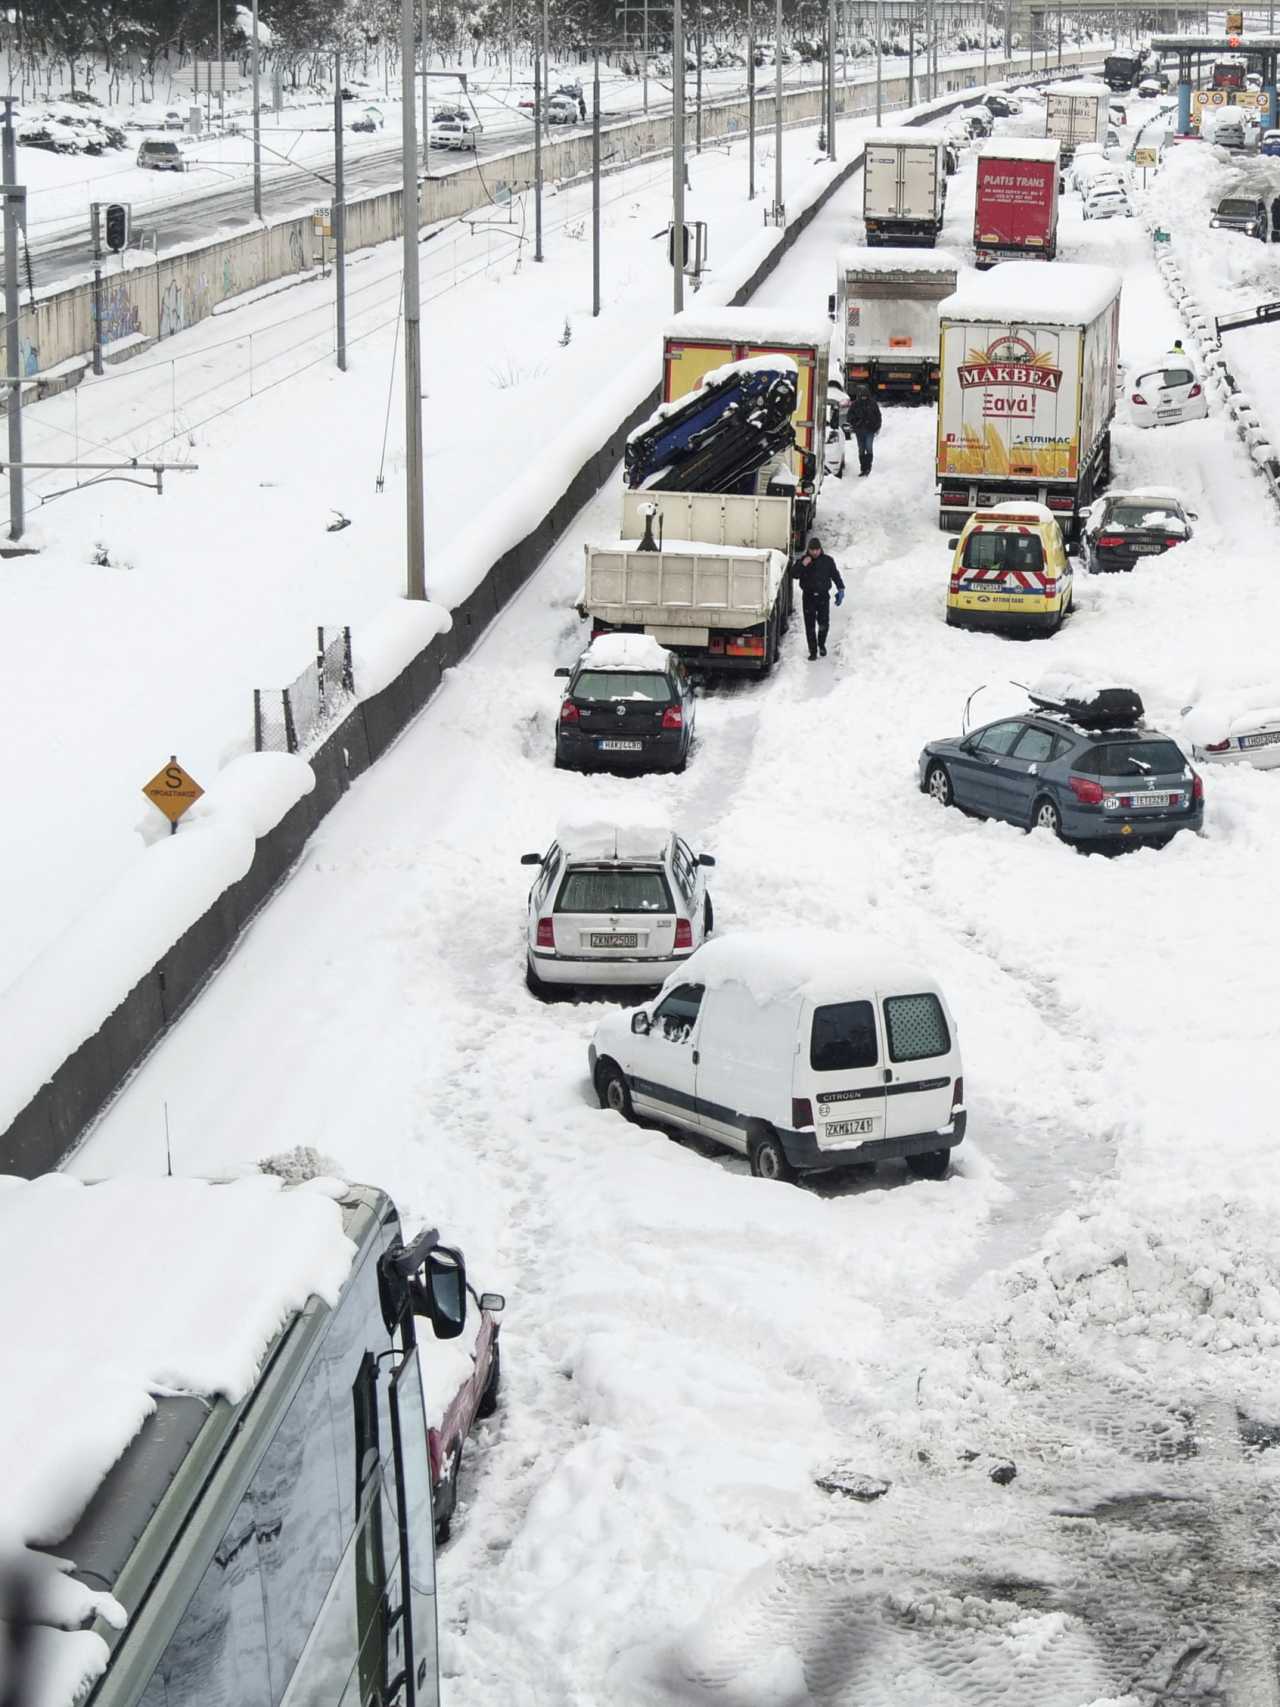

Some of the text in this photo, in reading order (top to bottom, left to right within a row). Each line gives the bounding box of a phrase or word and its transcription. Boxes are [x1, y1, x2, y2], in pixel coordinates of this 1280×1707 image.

[983, 175, 1045, 188] PLATIS TRANS
[983, 393, 1037, 413] Ξανά!
[1024, 435, 1071, 444] EURIMAC
[166, 767, 182, 788] S
[1106, 799, 1119, 809] CH
